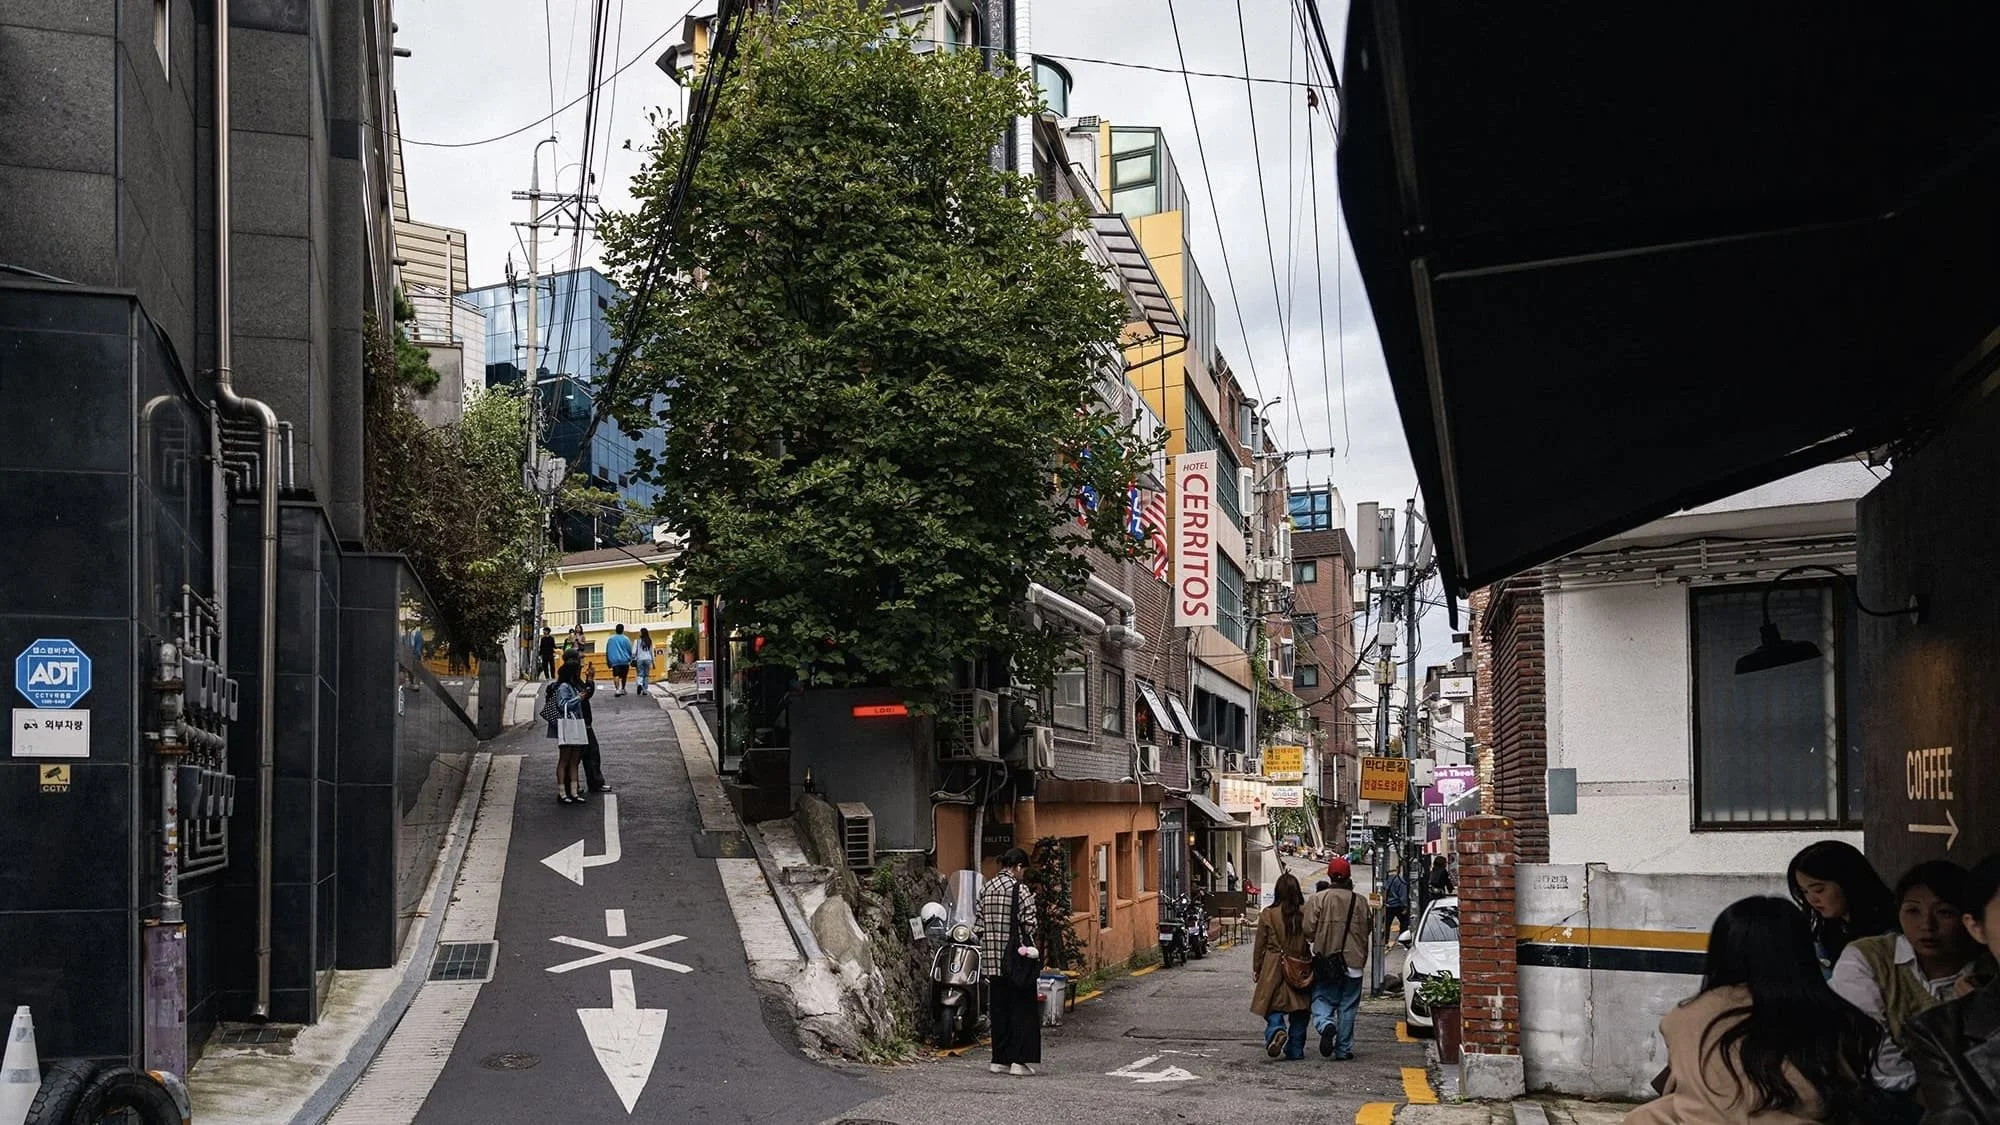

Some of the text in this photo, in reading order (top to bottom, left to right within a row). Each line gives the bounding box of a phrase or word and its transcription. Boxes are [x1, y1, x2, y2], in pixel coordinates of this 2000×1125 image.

[1183, 462, 1209, 472] HOTEL
[1182, 473, 1209, 617] CERRITOS
[29, 661, 79, 685] ADT
[45, 720, 83, 731] 외부차량
[1365, 760, 1406, 773] 막다른길
[1907, 746, 1953, 800] COFFEE
